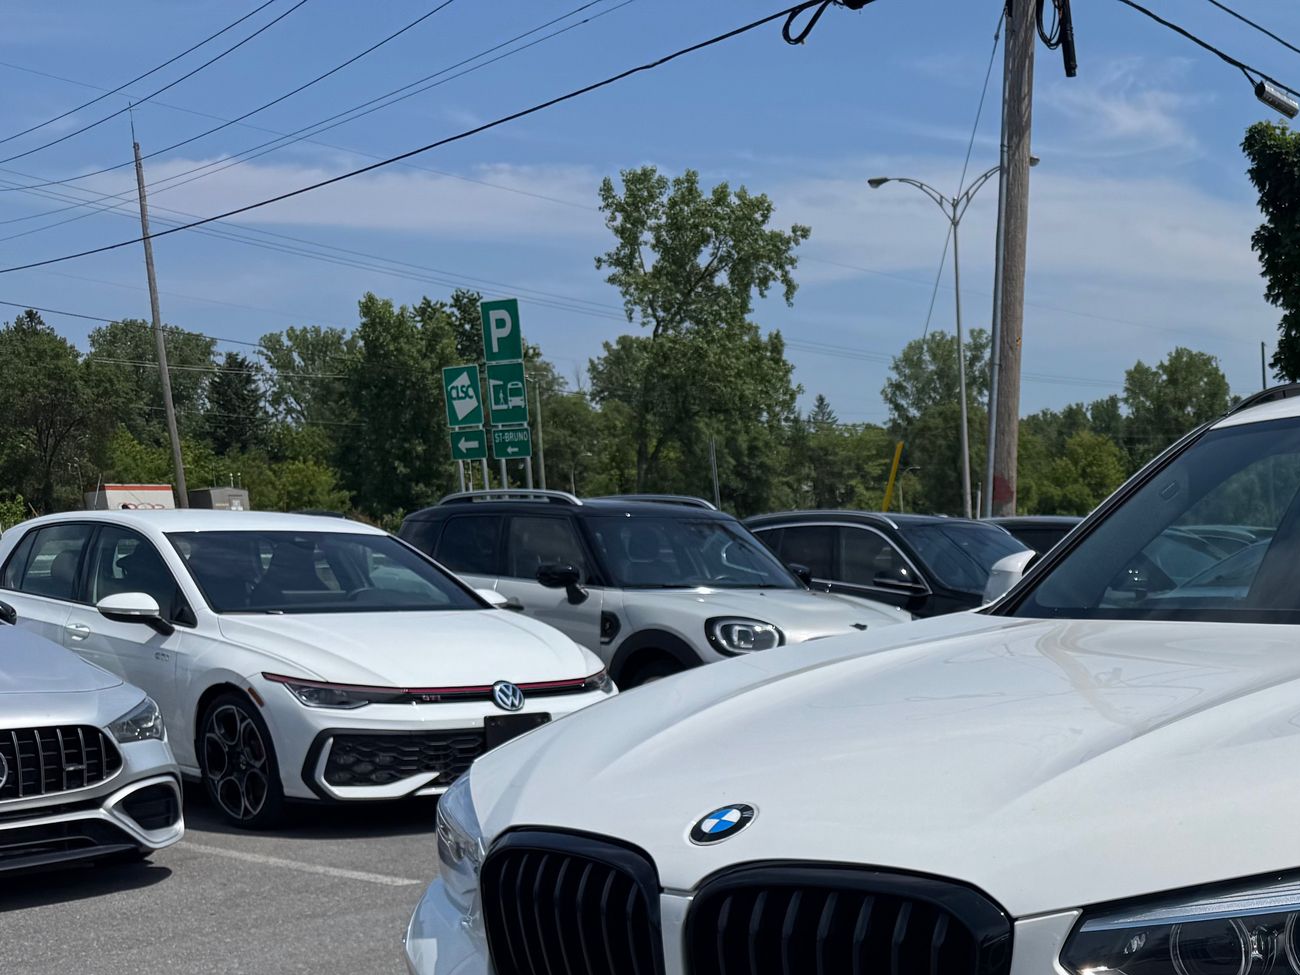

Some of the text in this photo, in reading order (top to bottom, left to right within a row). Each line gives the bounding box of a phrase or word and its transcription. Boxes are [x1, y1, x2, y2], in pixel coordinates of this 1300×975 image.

[489, 309, 512, 353] P
[449, 384, 474, 401] CLSC
[494, 431, 529, 443] ST-BRUNO
